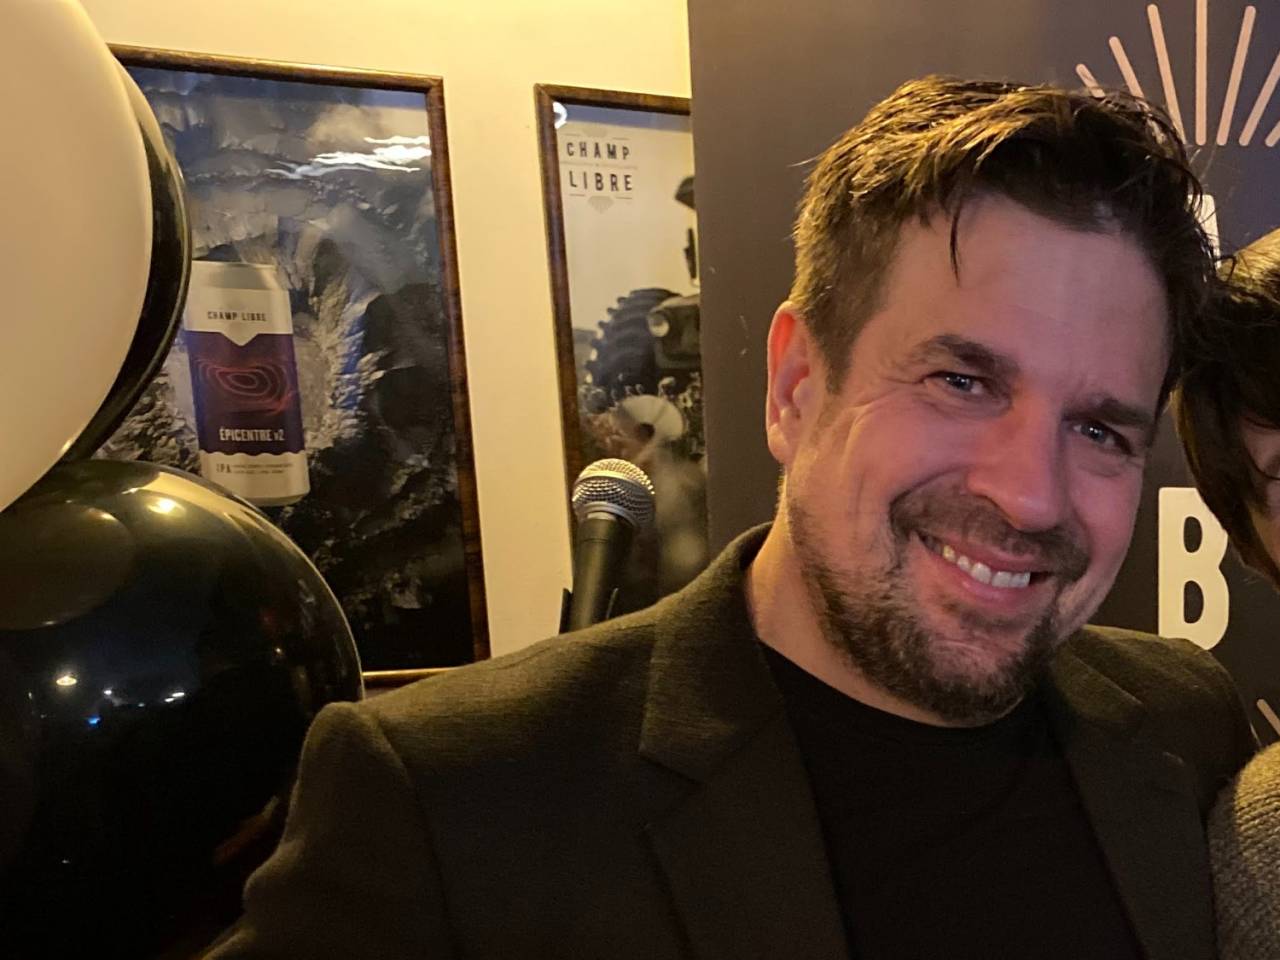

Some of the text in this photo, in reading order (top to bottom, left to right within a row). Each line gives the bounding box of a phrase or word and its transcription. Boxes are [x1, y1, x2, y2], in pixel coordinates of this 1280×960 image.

[566, 141, 630, 160] CHAMP
[568, 170, 633, 192] LIBRE
[207, 310, 239, 321] CHAMP
